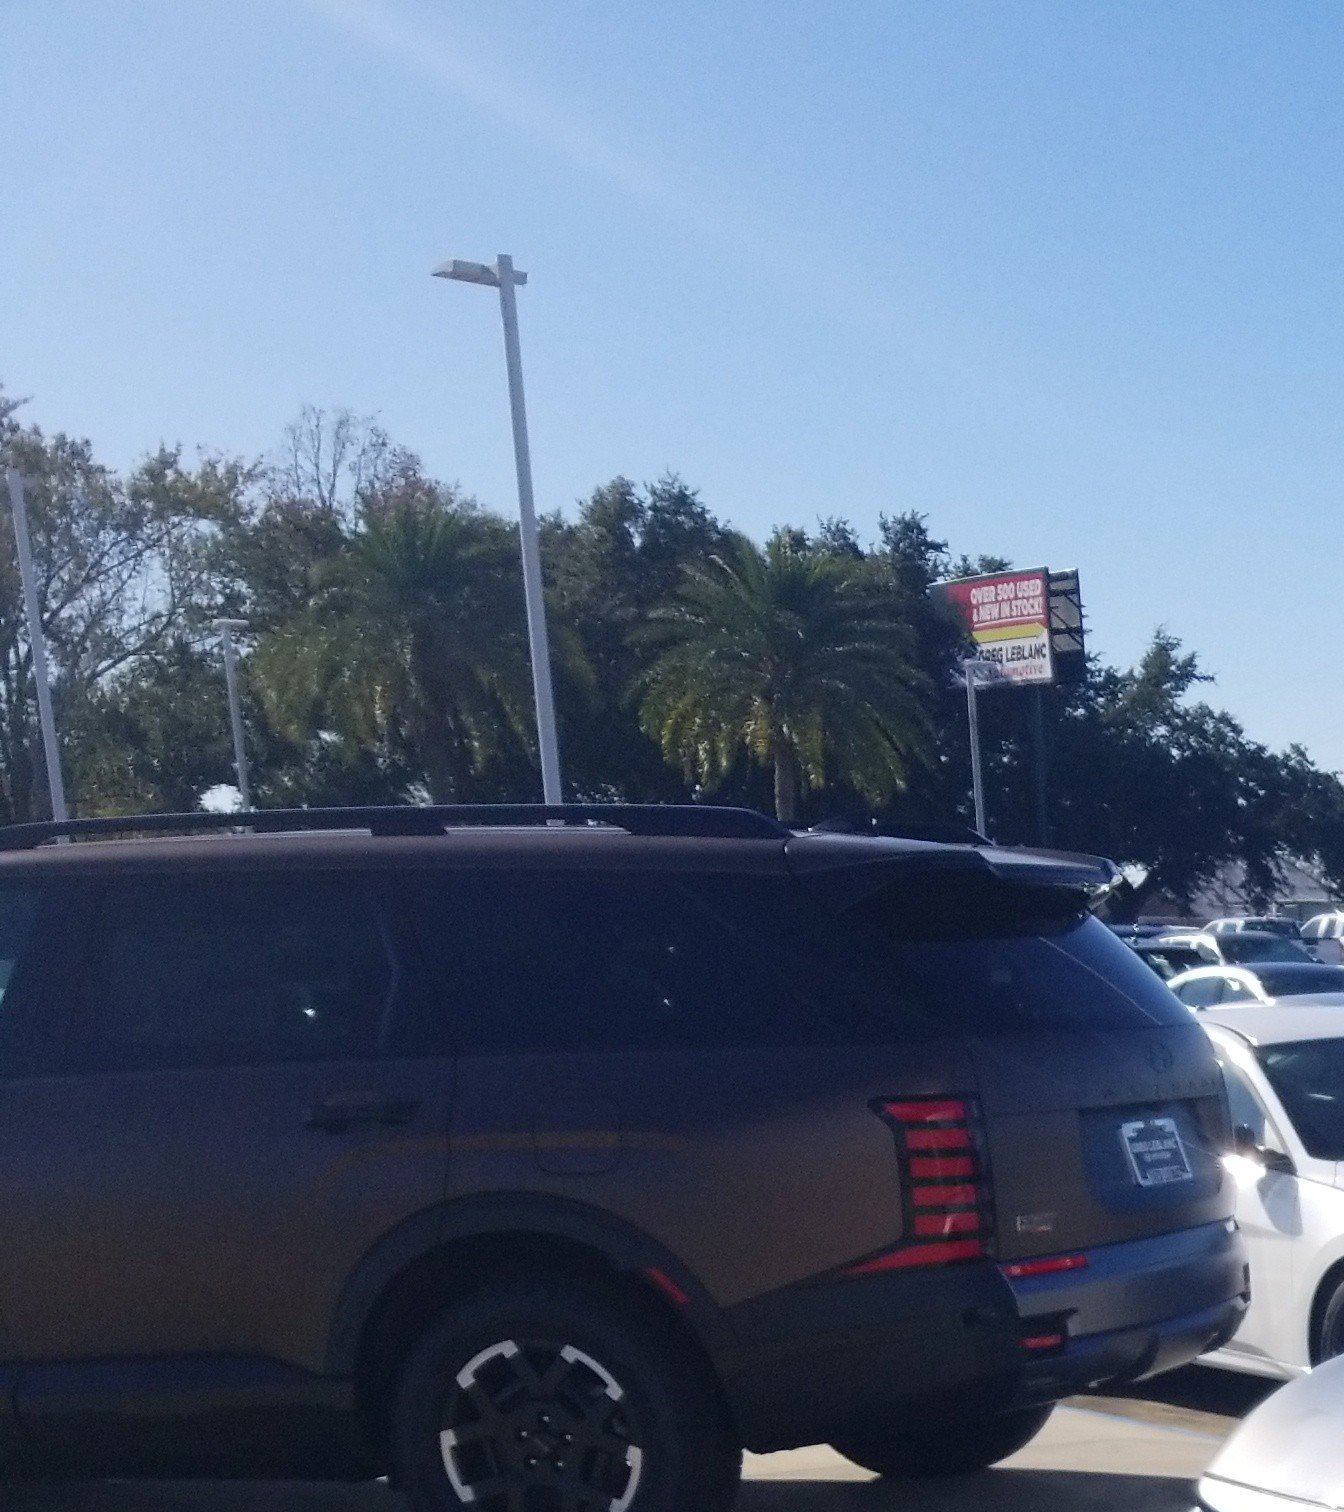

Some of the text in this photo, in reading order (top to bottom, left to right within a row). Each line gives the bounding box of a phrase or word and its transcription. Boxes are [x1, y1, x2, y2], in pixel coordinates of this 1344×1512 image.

[970, 585, 996, 605] OVER
[1016, 578, 1041, 598] USED
[1005, 643, 1047, 662] LEBLANC
